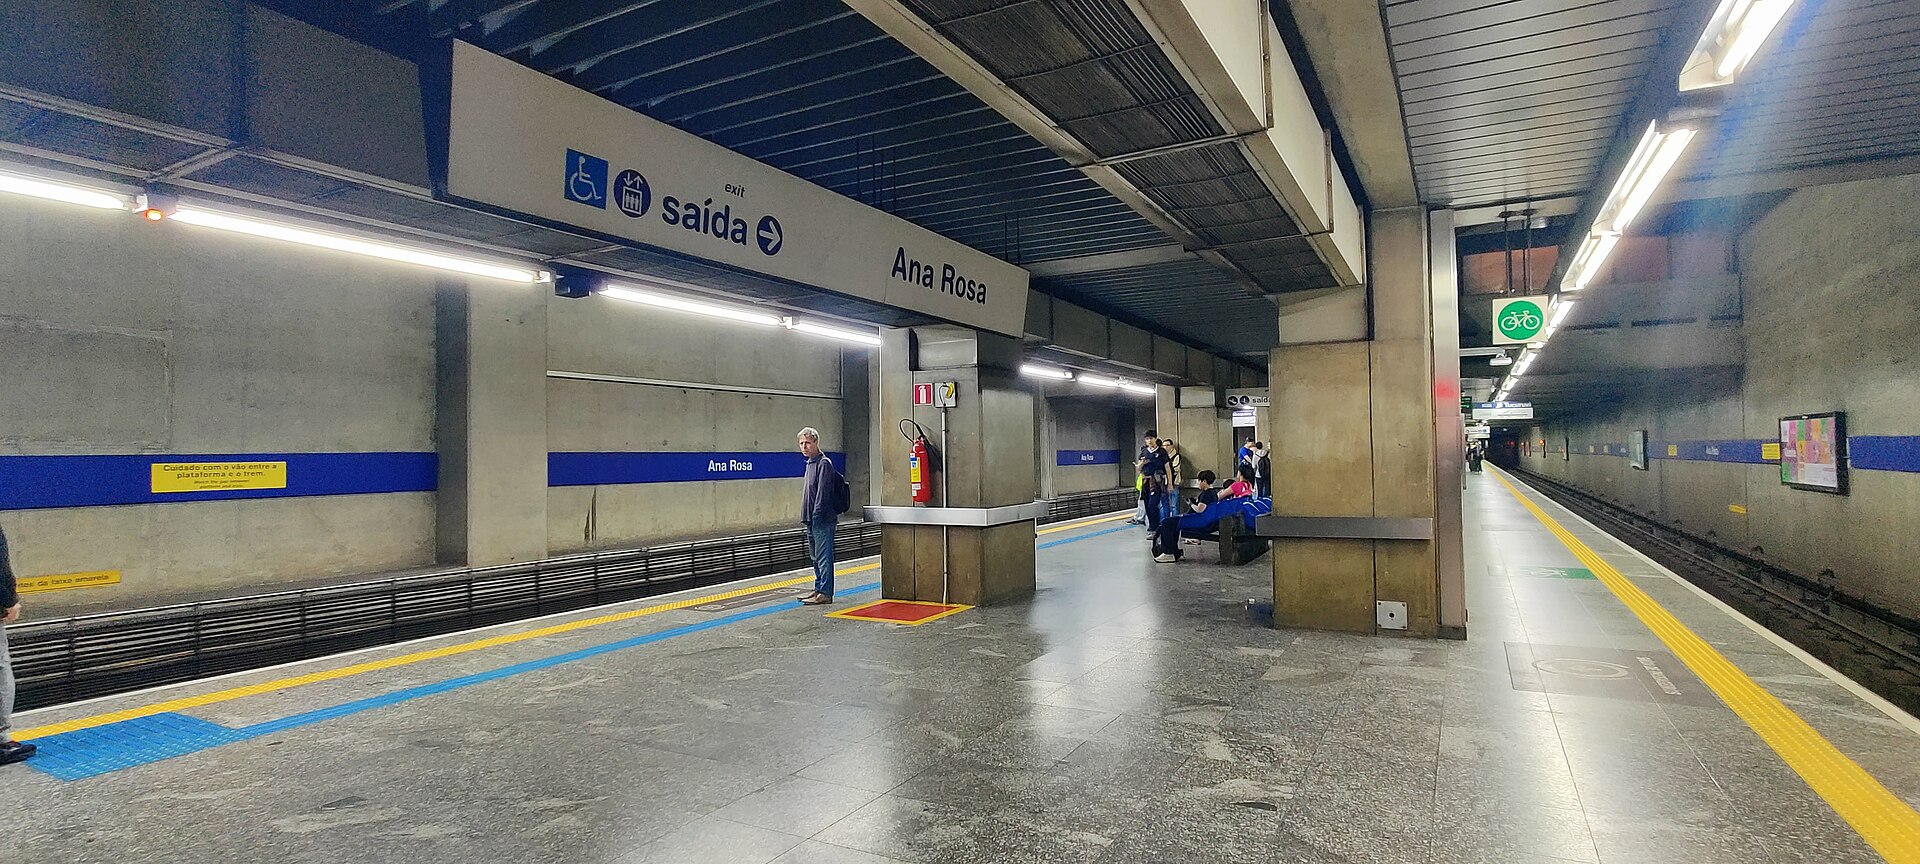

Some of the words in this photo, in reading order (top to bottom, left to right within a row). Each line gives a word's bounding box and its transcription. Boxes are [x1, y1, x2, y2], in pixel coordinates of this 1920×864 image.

[724, 182, 746, 198] exit
[662, 196, 748, 246] saída
[891, 246, 934, 289] Ana
[941, 263, 987, 305] Rosa
[163, 464, 200, 472] Cuidado
[708, 459, 727, 472] Ana
[730, 459, 753, 471] Rosa
[176, 470, 226, 479] plataforma
[75, 574, 109, 583] amarela
